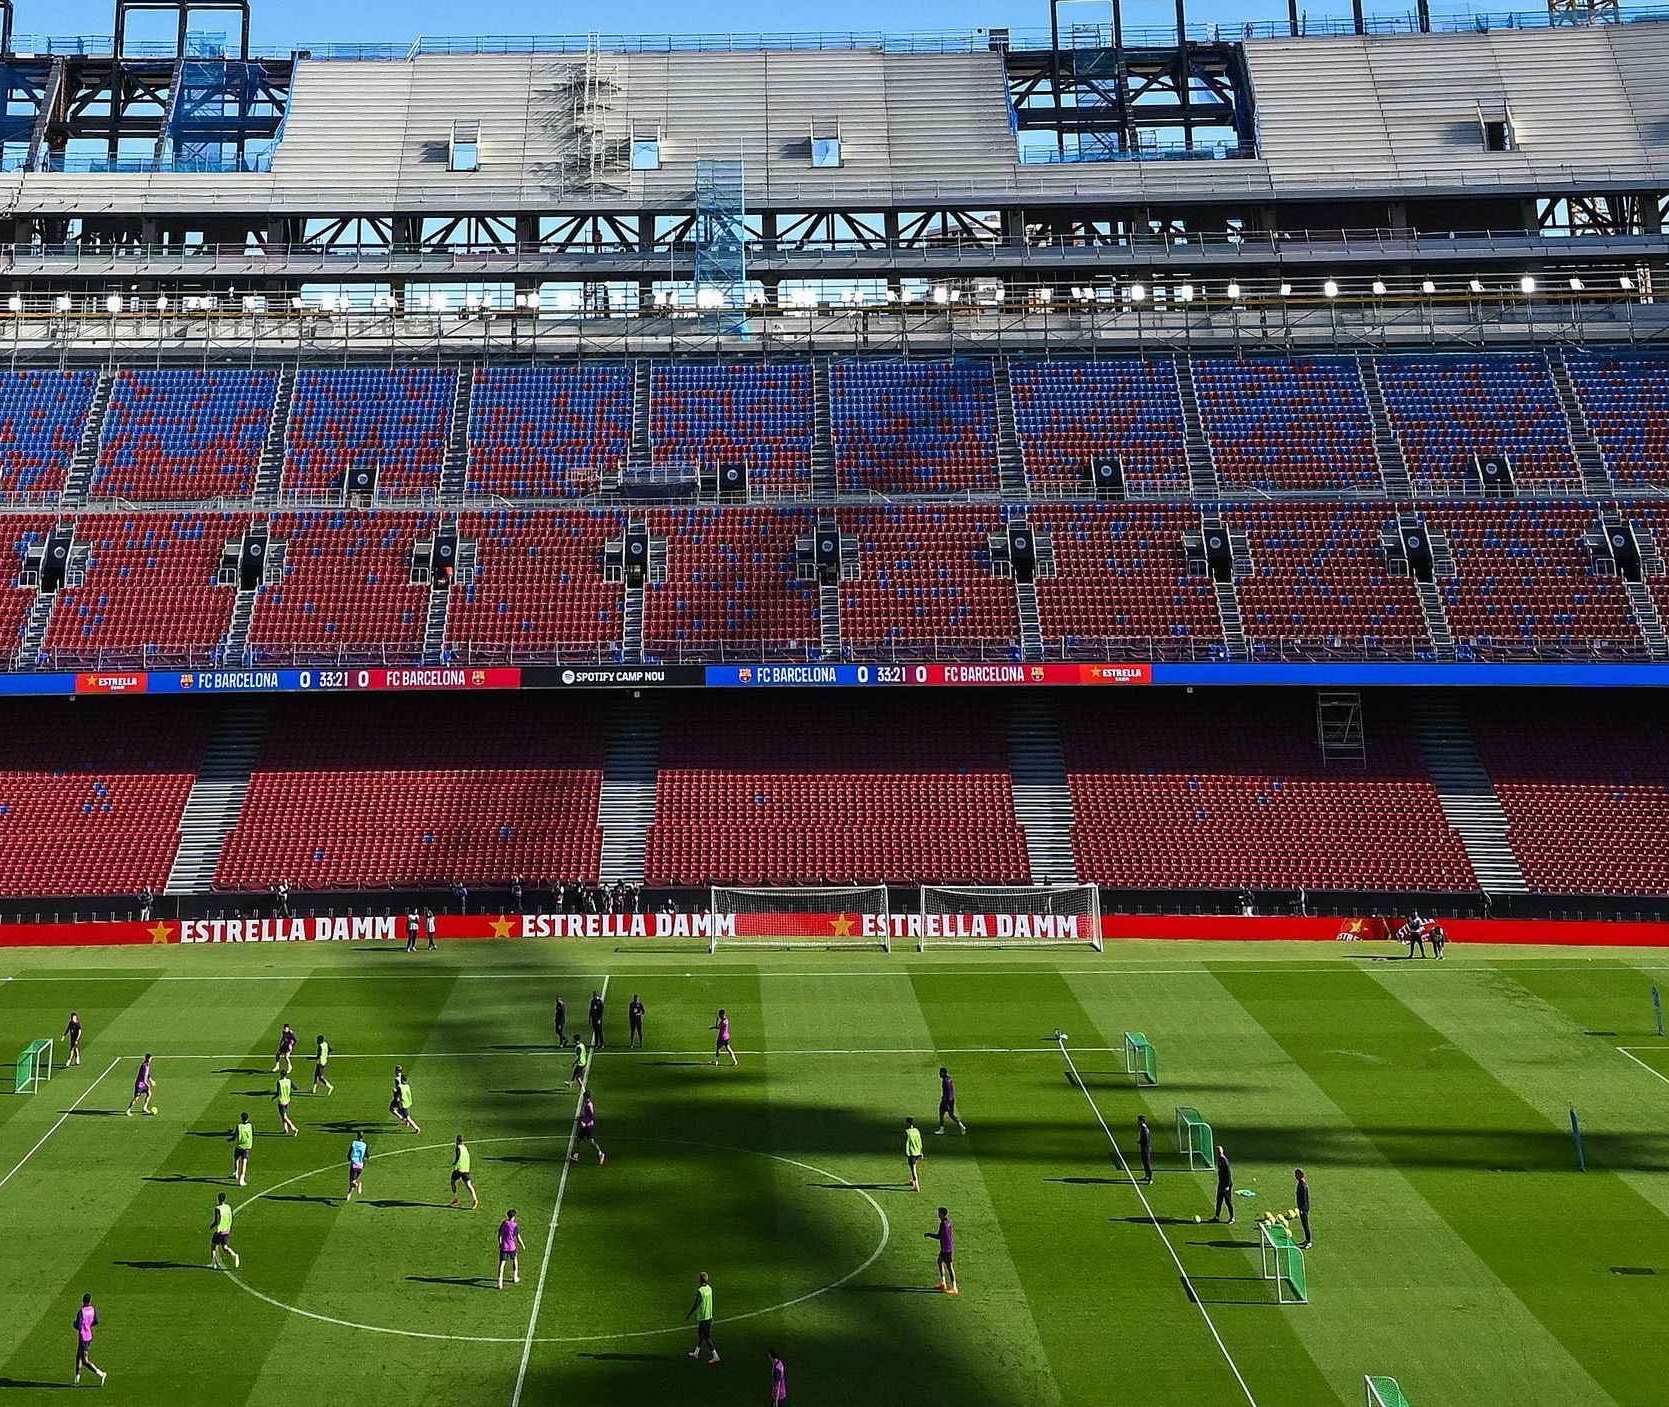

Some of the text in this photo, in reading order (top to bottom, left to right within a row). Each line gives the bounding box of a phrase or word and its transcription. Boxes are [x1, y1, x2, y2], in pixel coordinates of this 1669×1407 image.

[198, 671, 465, 688] FC BARCELONA 0 33:21 0 FC BARCELONA
[576, 671, 665, 682] SPOTIFY CAMP NOU
[757, 666, 1024, 682] FC BARCELONA 0 33:21 0 FC BARCELONA
[1102, 668, 1141, 677] ESTRELLA
[98, 677, 137, 686] ESTRELLA
[180, 915, 396, 943] ESTRELLA DAMM
[522, 912, 737, 938] ESTRELLA DAMM
[862, 913, 1077, 938] ESTRELLA DAMM
